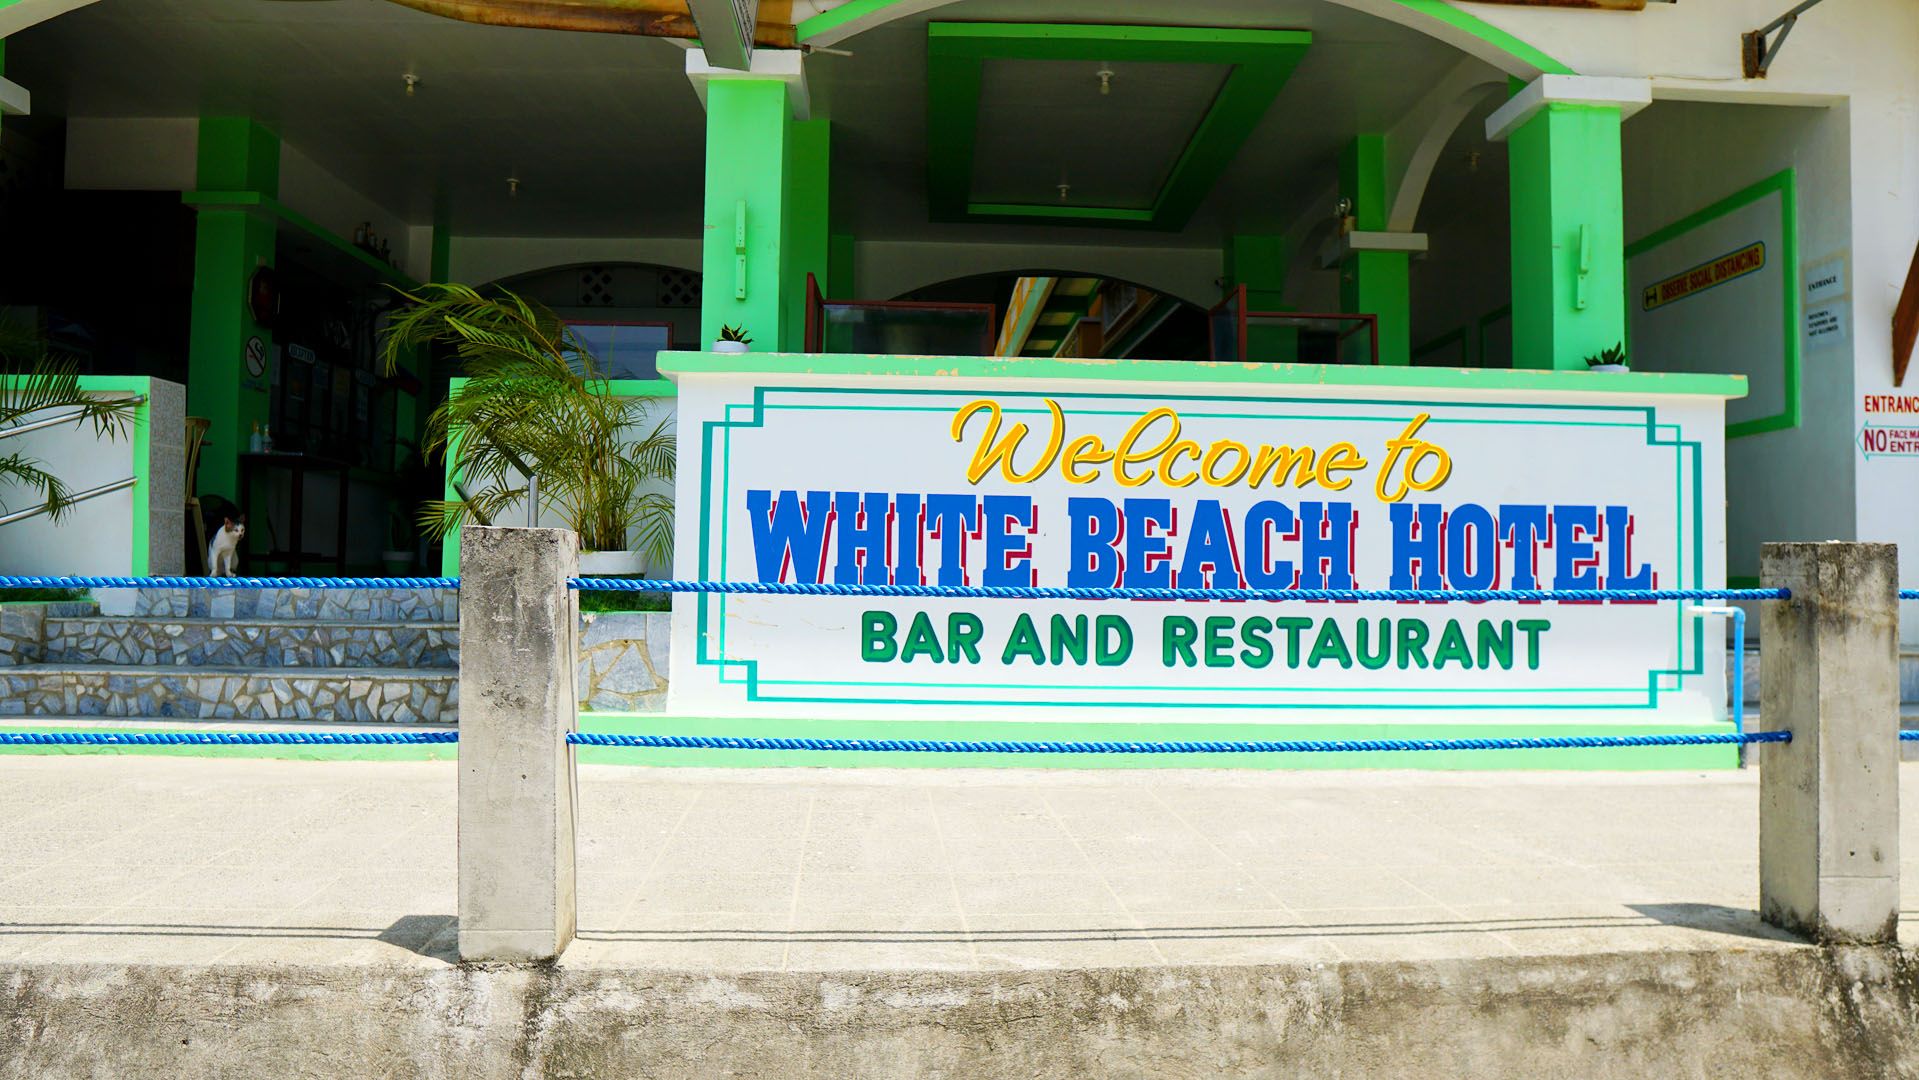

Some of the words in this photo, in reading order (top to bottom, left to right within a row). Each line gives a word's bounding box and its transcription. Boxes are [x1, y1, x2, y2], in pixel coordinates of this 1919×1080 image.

[1662, 274, 1688, 301] OBSERVE
[1689, 266, 1713, 291] SOCIAL
[1715, 247, 1760, 281] DISTANCING
[1808, 275, 1836, 292] ENTRANCE
[951, 398, 1368, 490] Welcome
[1375, 412, 1453, 502] to
[1864, 429, 1887, 452] NO
[1889, 430, 1908, 439] FACE
[746, 489, 1039, 599] WHITE
[1067, 496, 1359, 602] BEACH
[1388, 502, 1659, 605] HOTEL
[861, 610, 984, 665] BAR
[1001, 612, 1134, 668] AND
[1162, 615, 1552, 670] RESTAURANT
